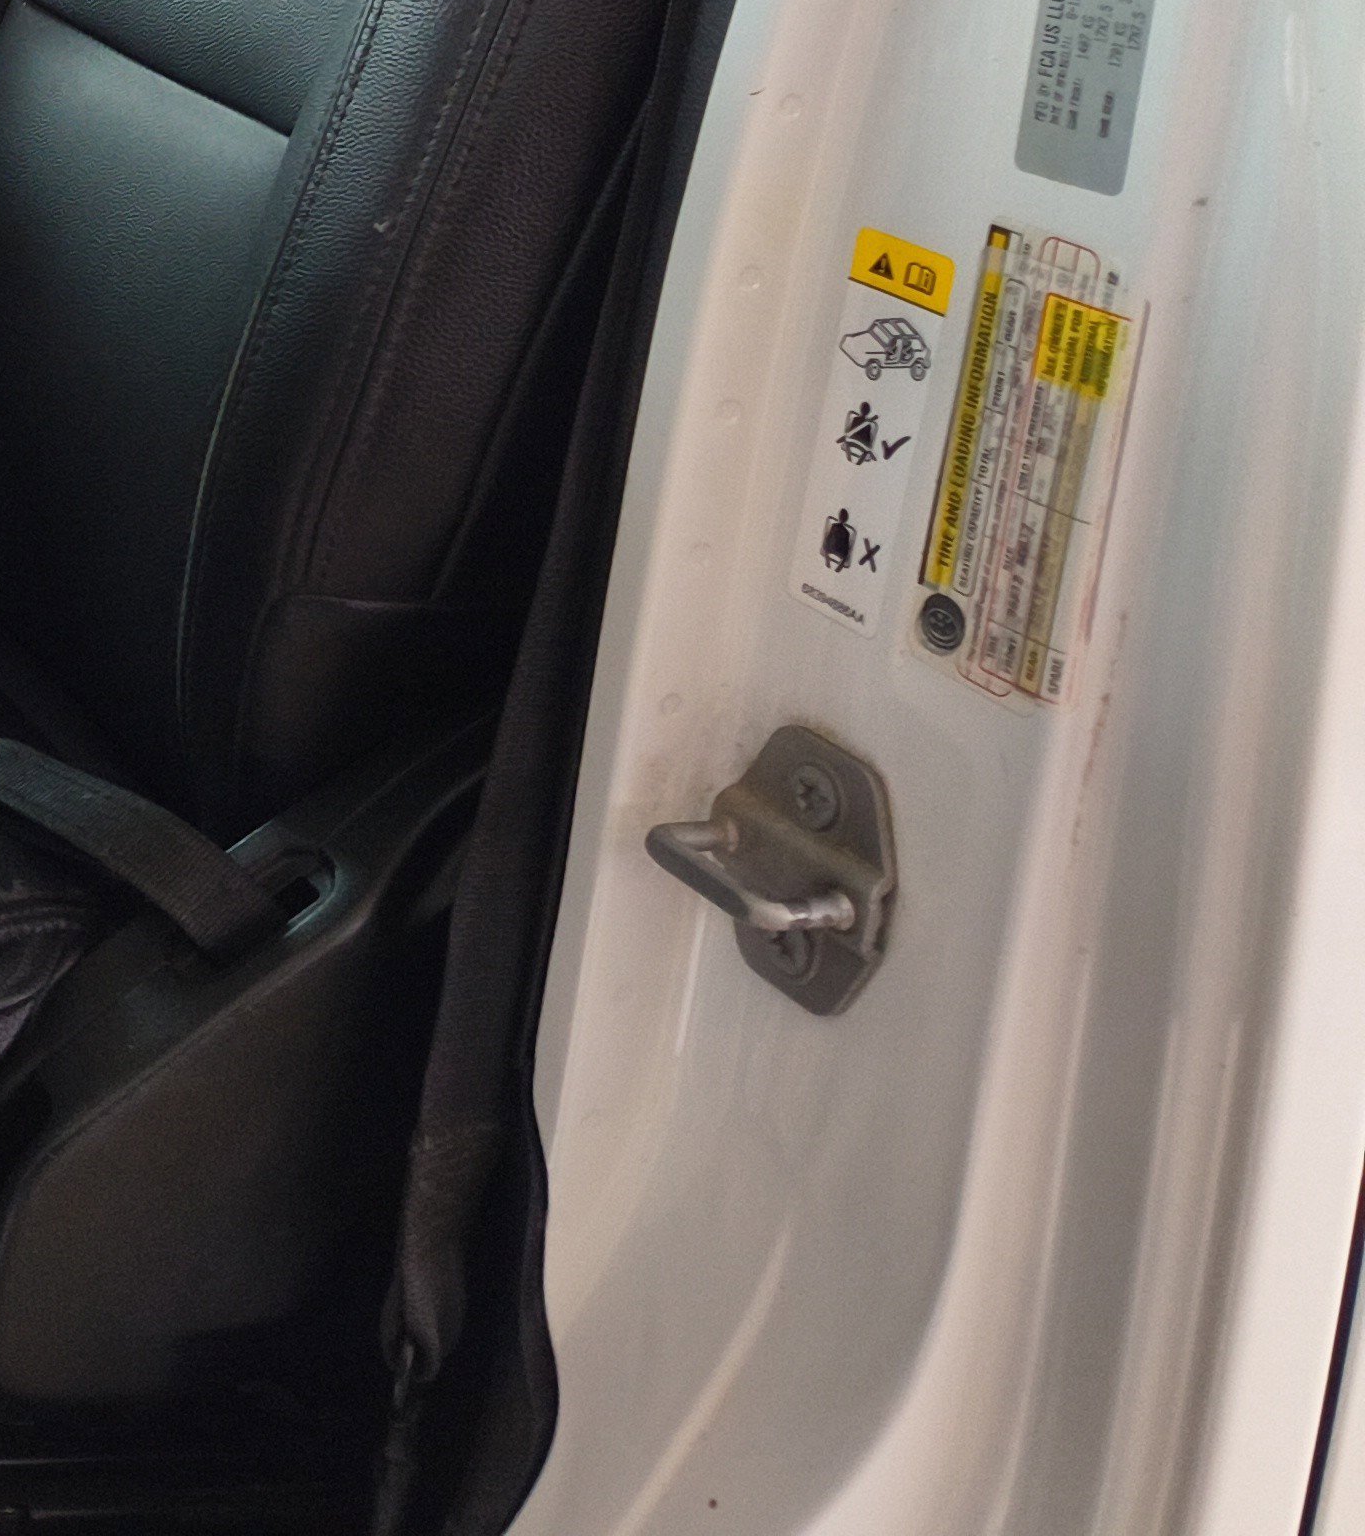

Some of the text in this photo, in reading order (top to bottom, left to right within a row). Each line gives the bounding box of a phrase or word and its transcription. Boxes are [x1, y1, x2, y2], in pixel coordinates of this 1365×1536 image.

[1041, 23, 1061, 45] US
[1036, 48, 1057, 77] FCA
[941, 489, 965, 529] AND
